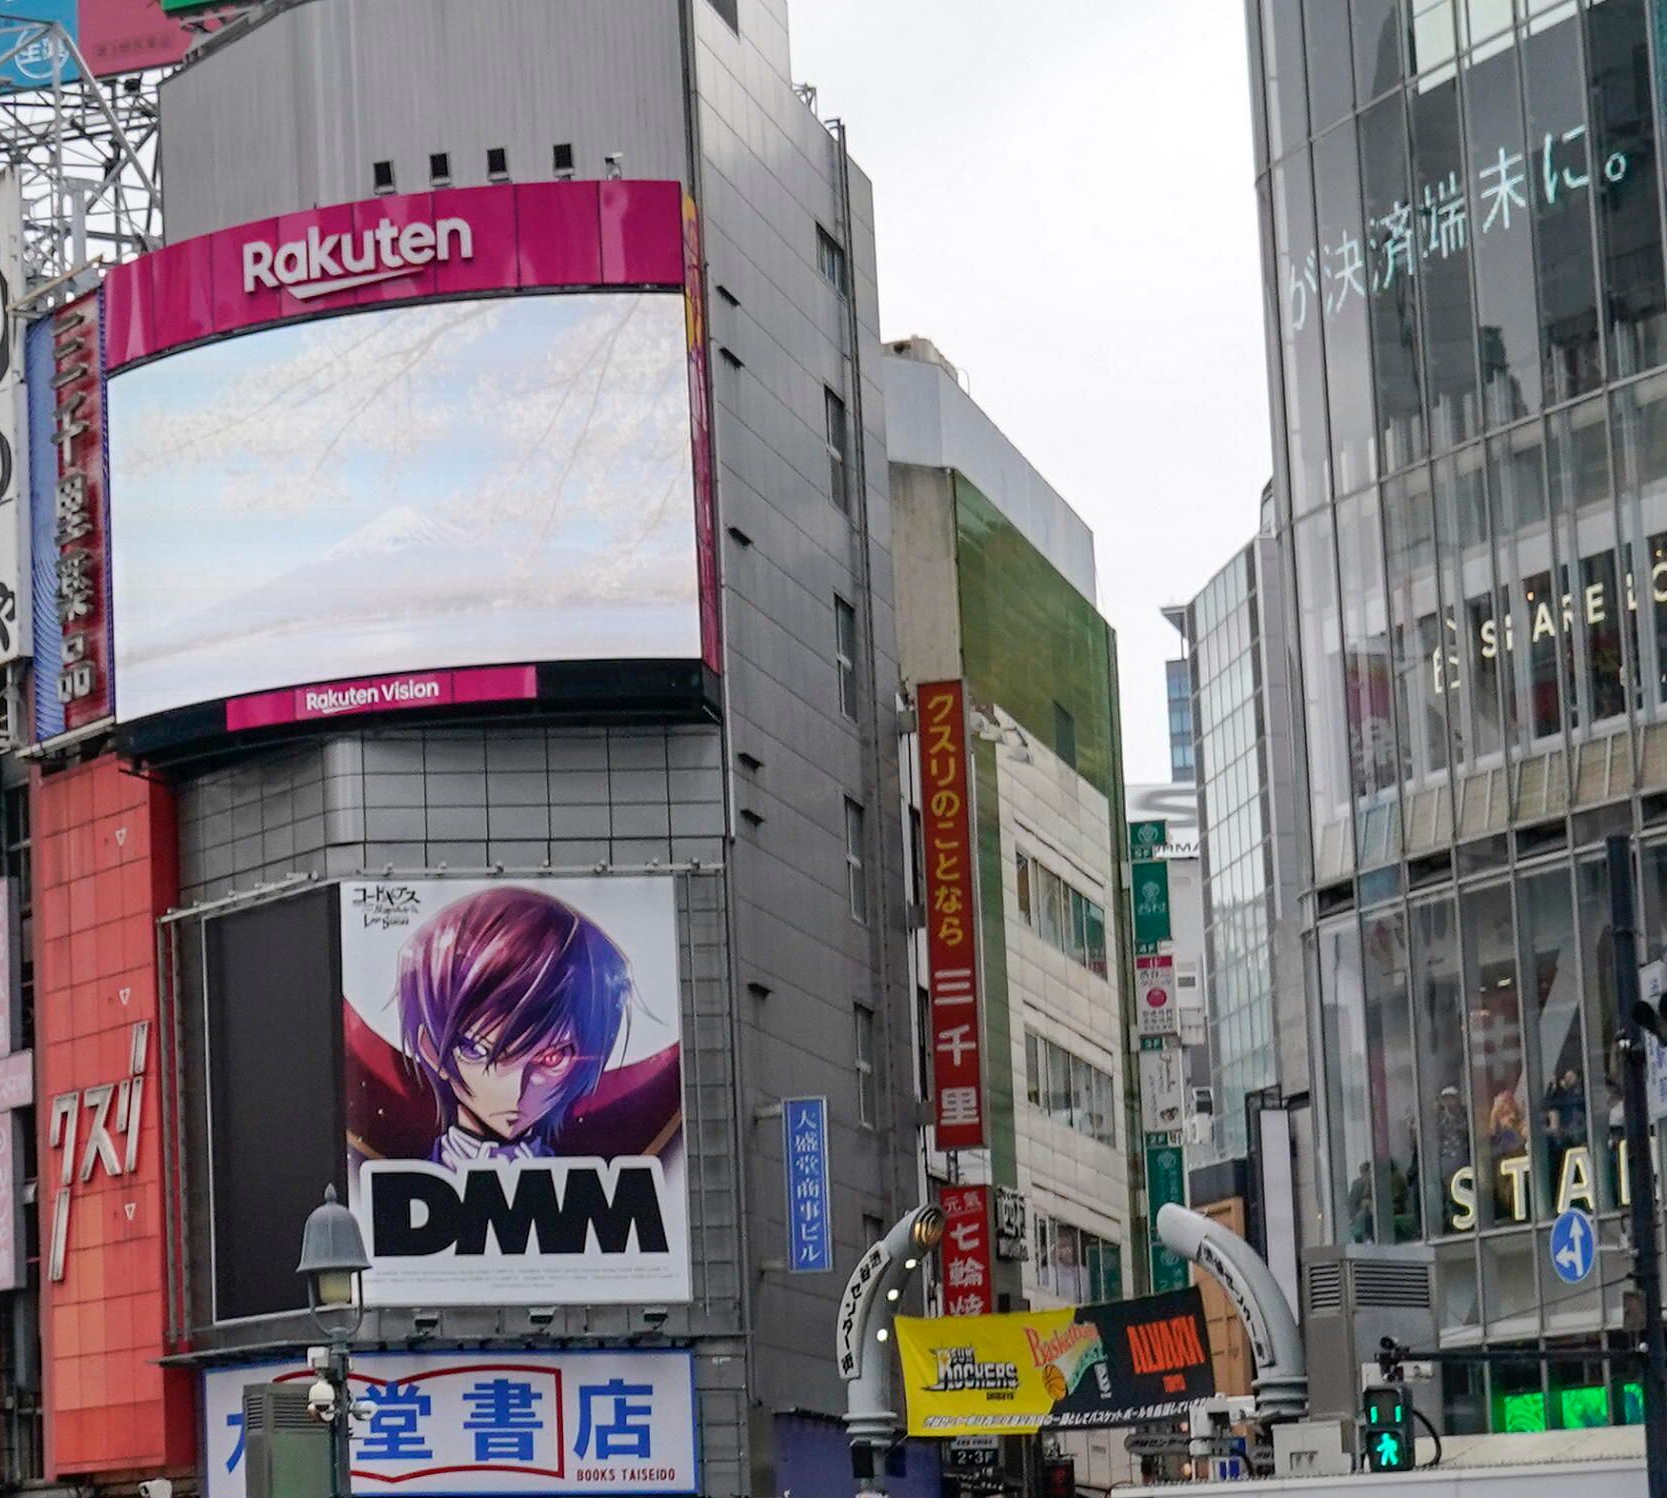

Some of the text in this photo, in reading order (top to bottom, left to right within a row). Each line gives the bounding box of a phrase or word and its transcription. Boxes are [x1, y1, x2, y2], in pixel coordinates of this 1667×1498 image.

[243, 215, 473, 295] Rakuten
[306, 679, 440, 711] Rakuten Vision
[927, 694, 980, 1127] クスリのことなら 三千里
[371, 1167, 670, 1257] DMM
[576, 1468, 676, 1482] BOOKS TAISEIDO
